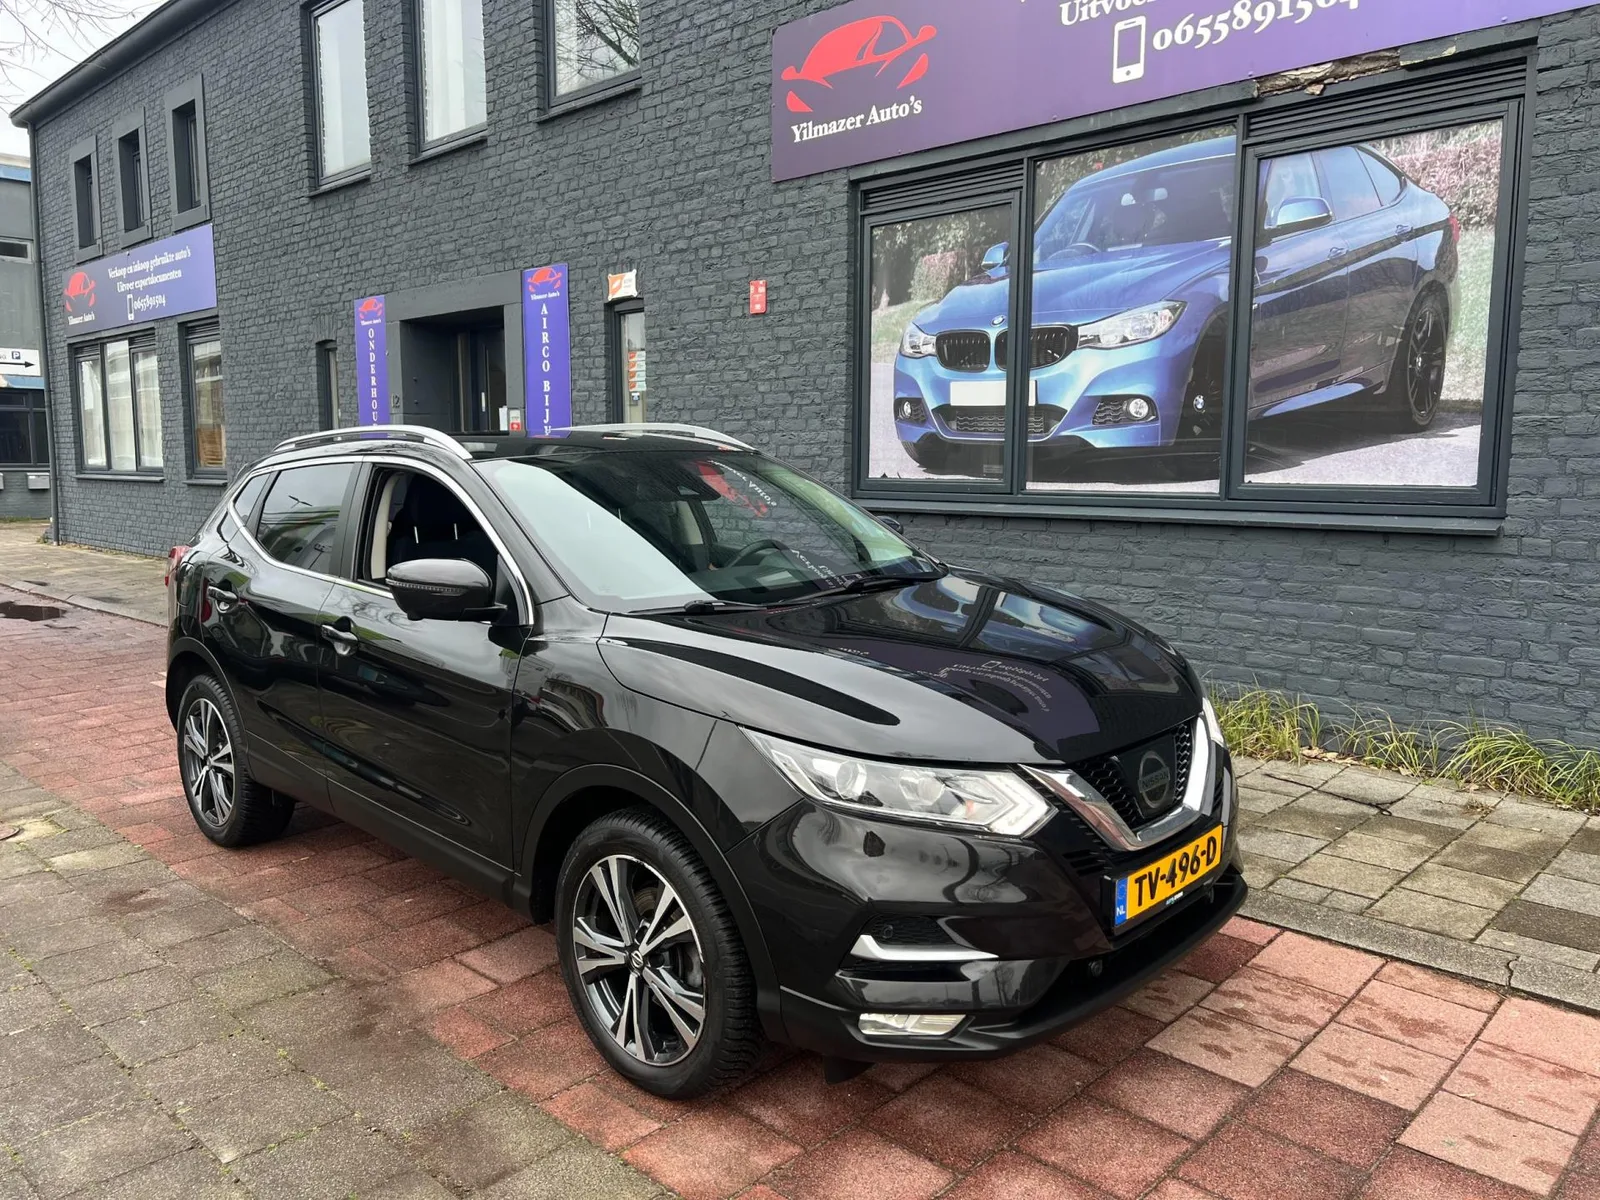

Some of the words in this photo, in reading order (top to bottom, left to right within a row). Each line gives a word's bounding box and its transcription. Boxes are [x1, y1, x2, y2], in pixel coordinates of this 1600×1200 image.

[1059, 0, 1157, 25] Uitvo
[1152, 0, 1359, 50] 06558915
[791, 113, 865, 143] Yilmazer
[866, 95, 922, 126] Auto's
[540, 303, 551, 373] AIRCO
[368, 328, 378, 426] ONDERHOU
[1134, 835, 1217, 907] TV-496-D
[1116, 904, 1126, 916] NL
